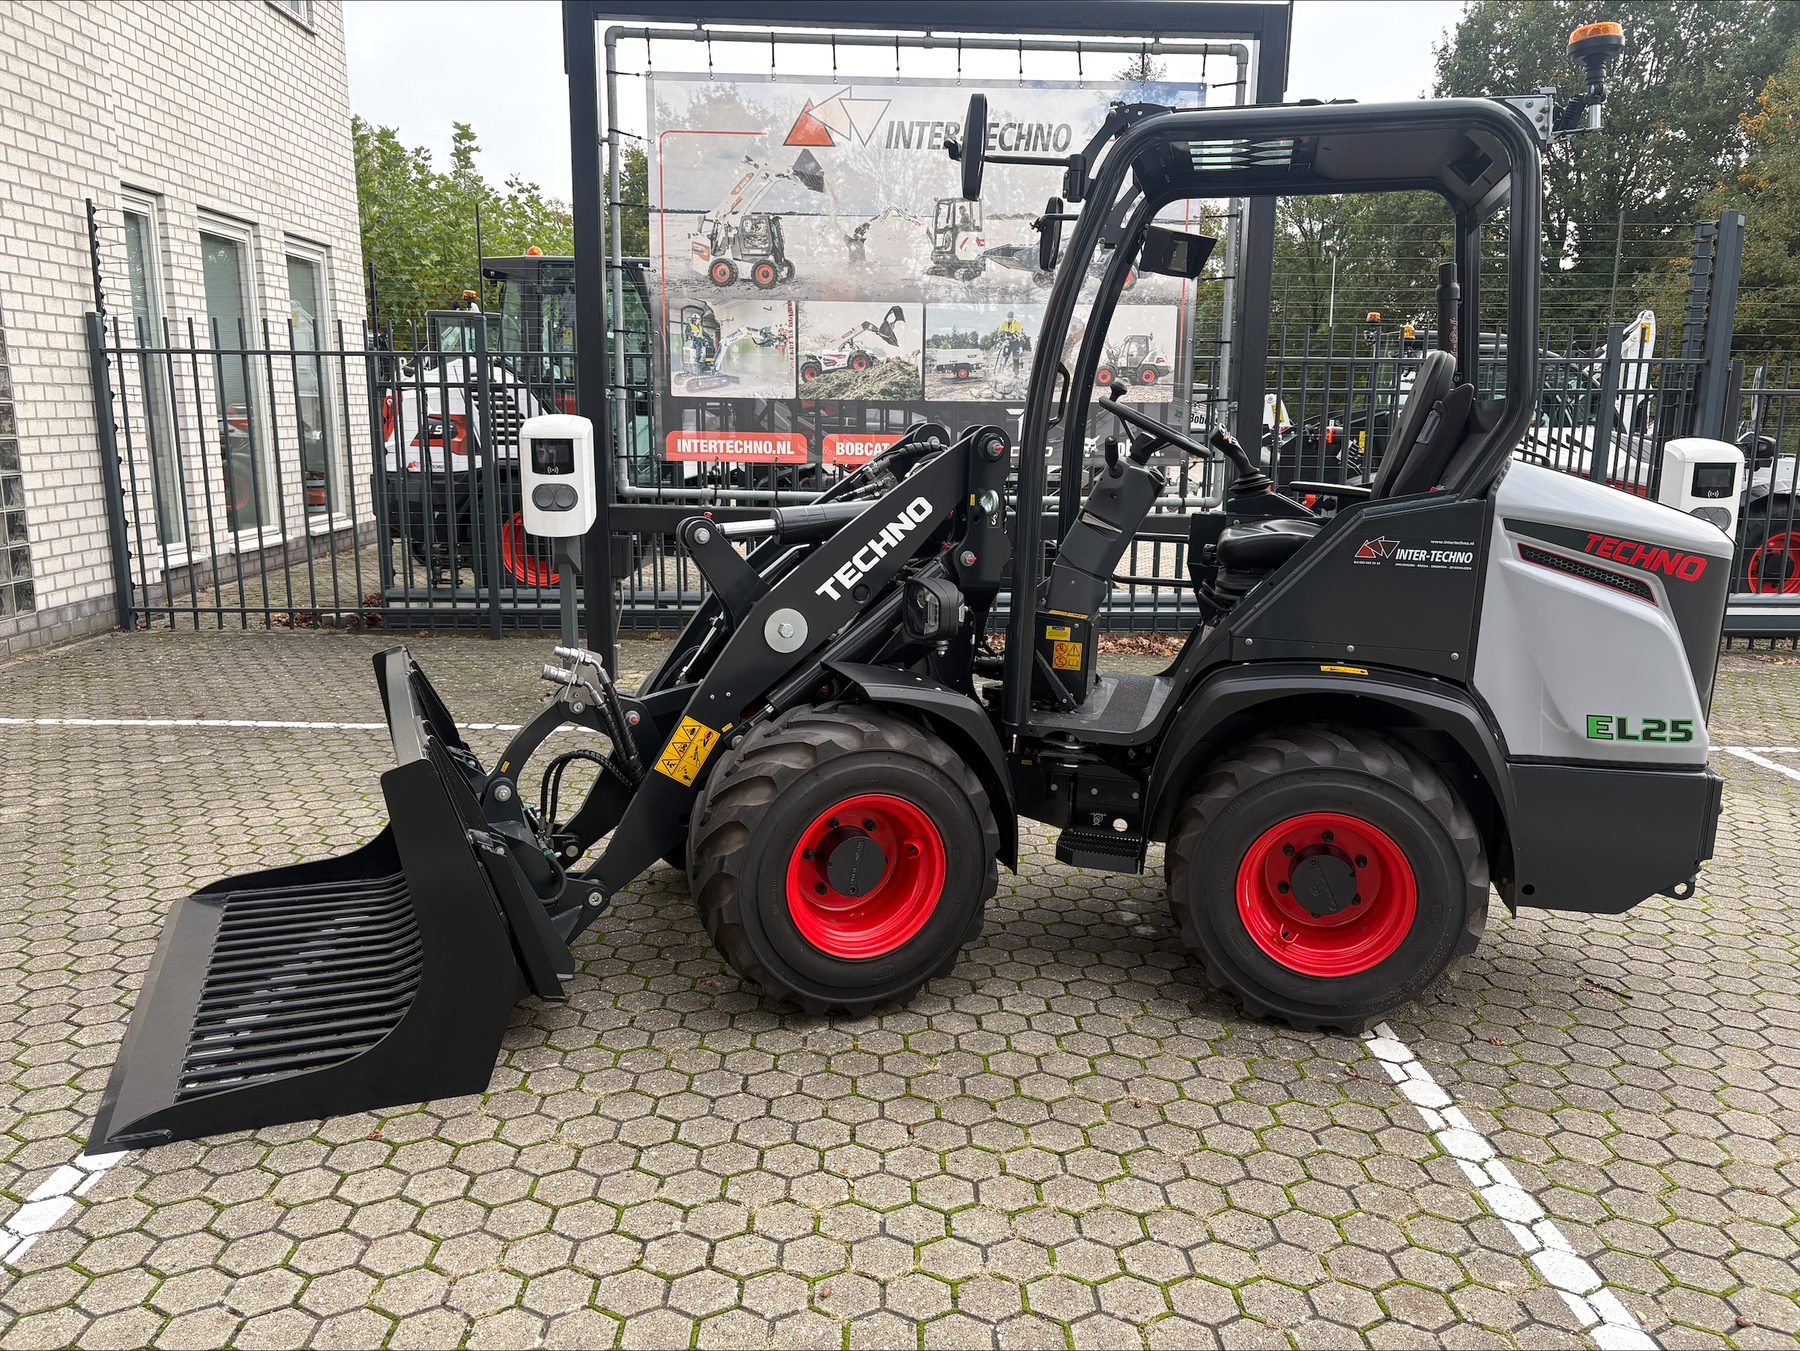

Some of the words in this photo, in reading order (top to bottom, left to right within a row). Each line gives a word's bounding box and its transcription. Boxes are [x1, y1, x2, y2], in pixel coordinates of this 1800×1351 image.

[885, 120, 1072, 152] INTER-ECHNO
[677, 439, 795, 455] INTERTECHNO.NL
[815, 496, 933, 601] TECHNO
[1395, 548, 1473, 563] INTER-TECHNO
[1584, 533, 1708, 582] TECHNO
[1586, 714, 1696, 743] EL25
